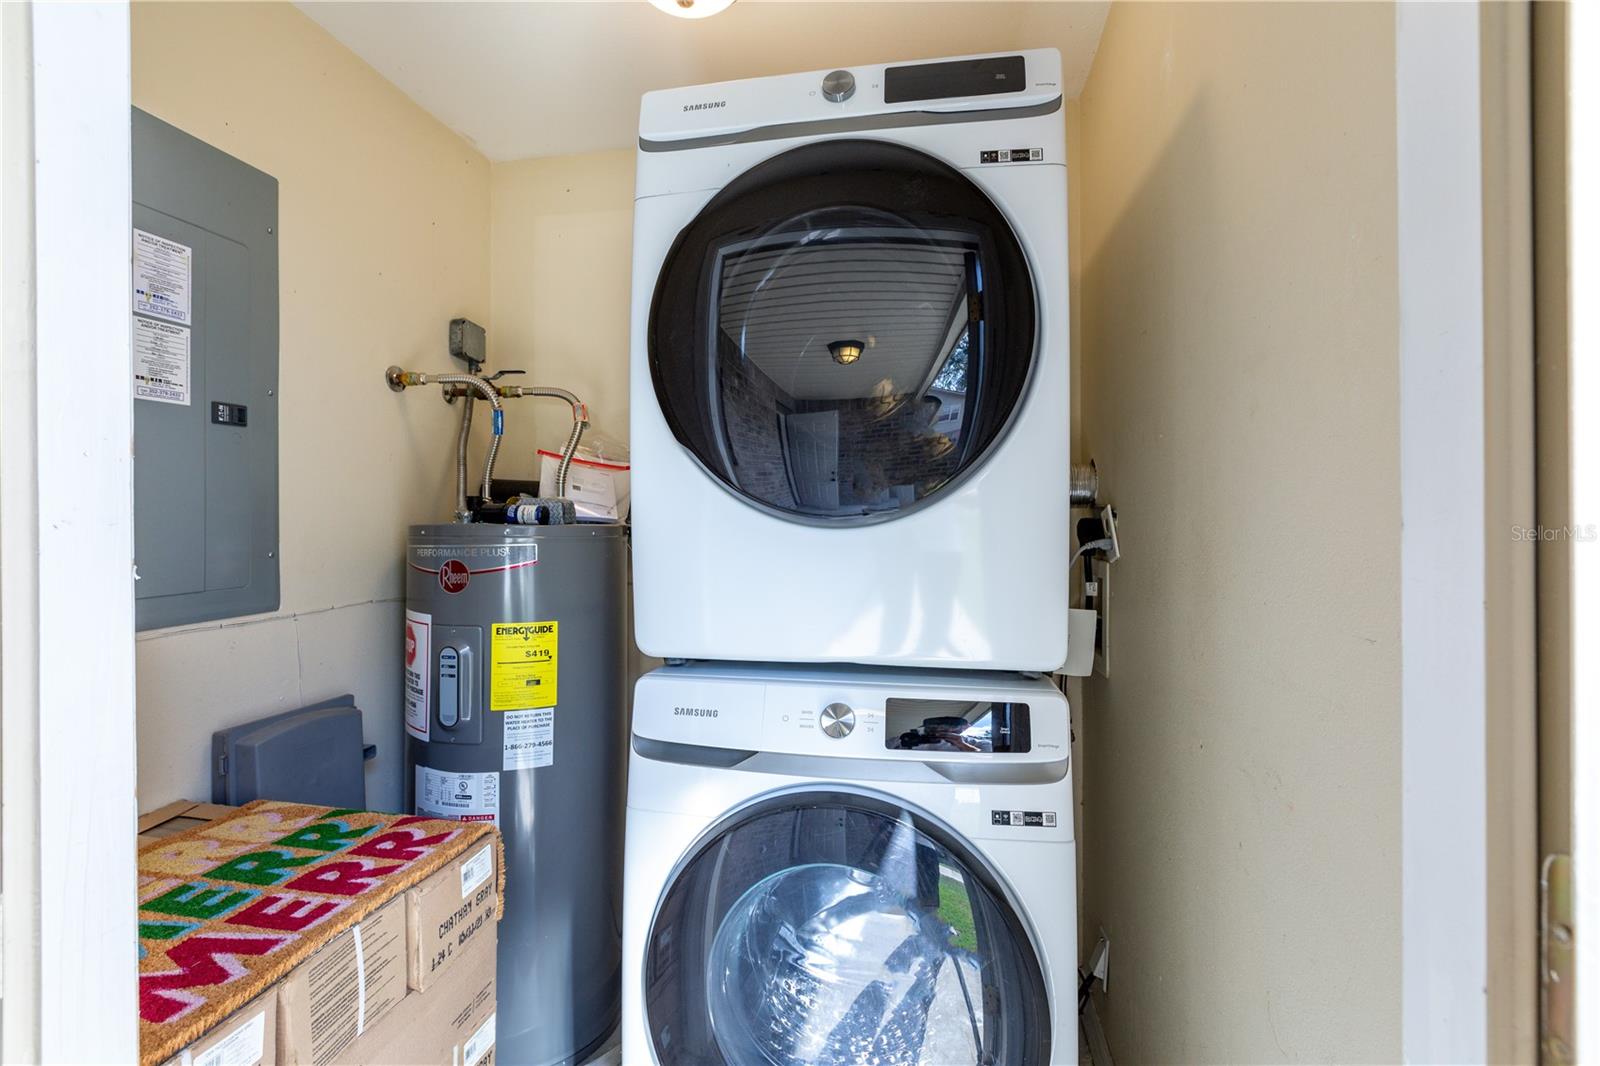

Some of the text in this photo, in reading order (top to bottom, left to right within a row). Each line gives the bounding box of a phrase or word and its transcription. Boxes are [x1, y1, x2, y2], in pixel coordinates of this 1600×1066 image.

[683, 101, 726, 112] SAMSUNG
[416, 547, 506, 558] PERFORMANCE PLUS
[442, 560, 468, 589] Rheem
[496, 624, 554, 636] ENERGYGUIDE
[674, 707, 719, 718] SAMSUNG
[438, 900, 472, 939] CHATHAM
